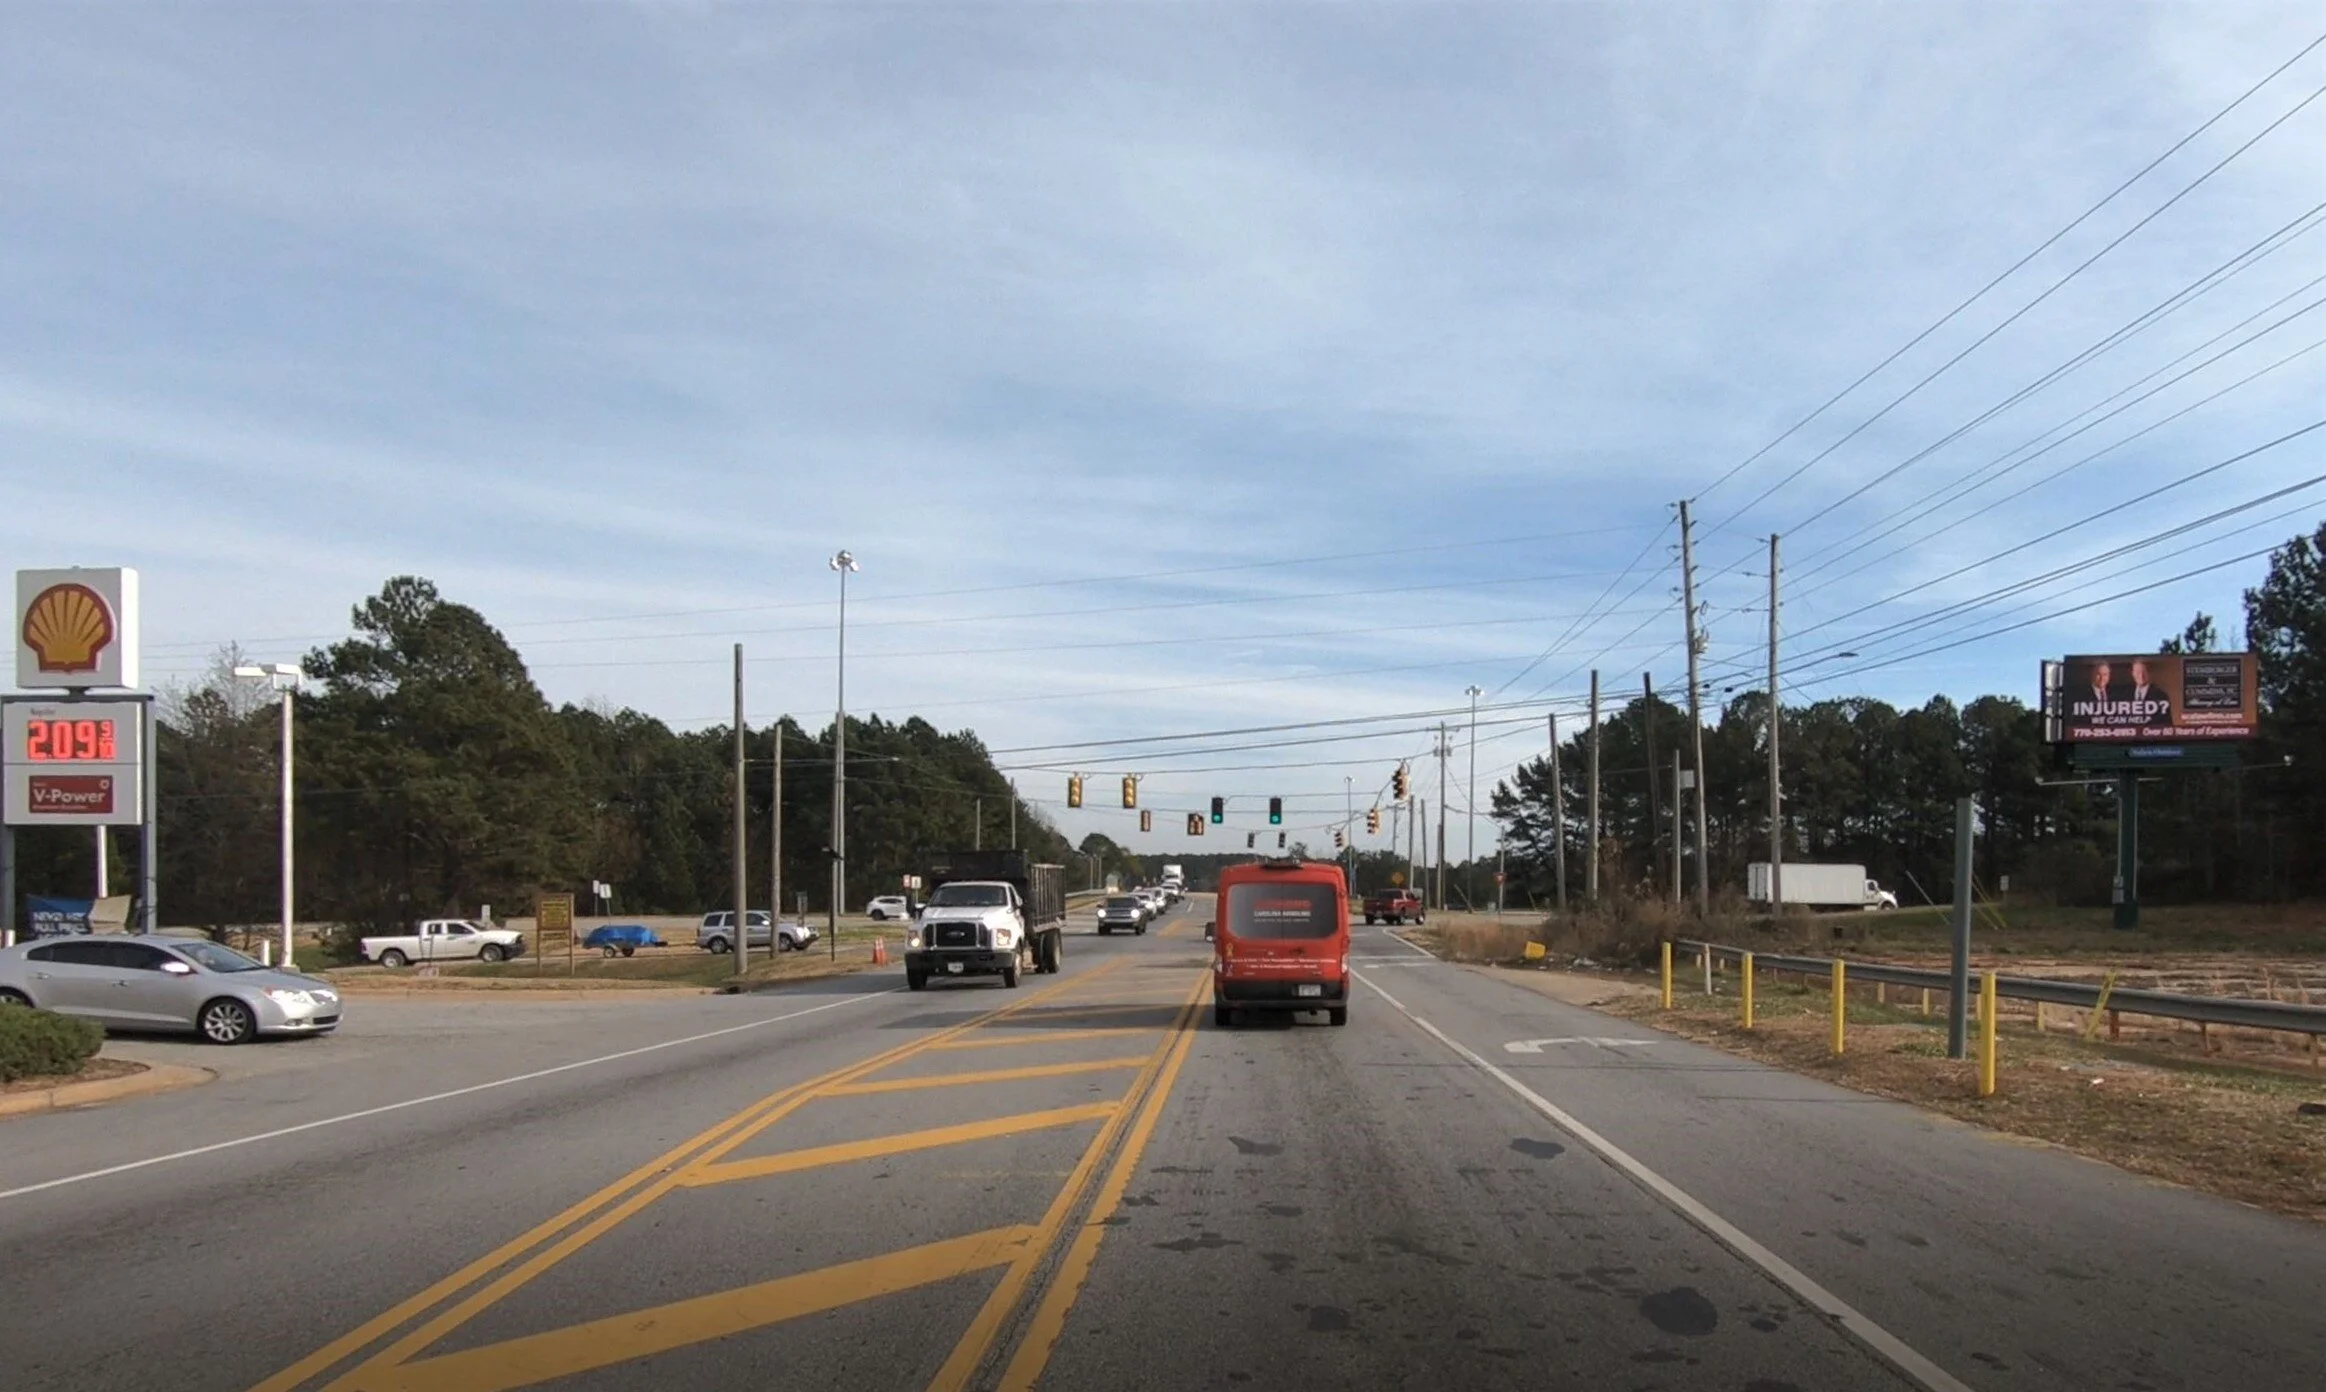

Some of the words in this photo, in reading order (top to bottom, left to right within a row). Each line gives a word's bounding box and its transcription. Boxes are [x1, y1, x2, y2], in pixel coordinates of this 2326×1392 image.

[2073, 701, 2170, 715] INJURED?
[2091, 716, 2105, 725] WE
[2107, 716, 2127, 725] CAN
[2128, 716, 2152, 725] HELP
[2142, 727, 2162, 737] Over
[2175, 727, 2196, 736] Years
[2196, 726, 2206, 736] of
[2205, 726, 2250, 738] Experience
[33, 788, 106, 803] V-Power
